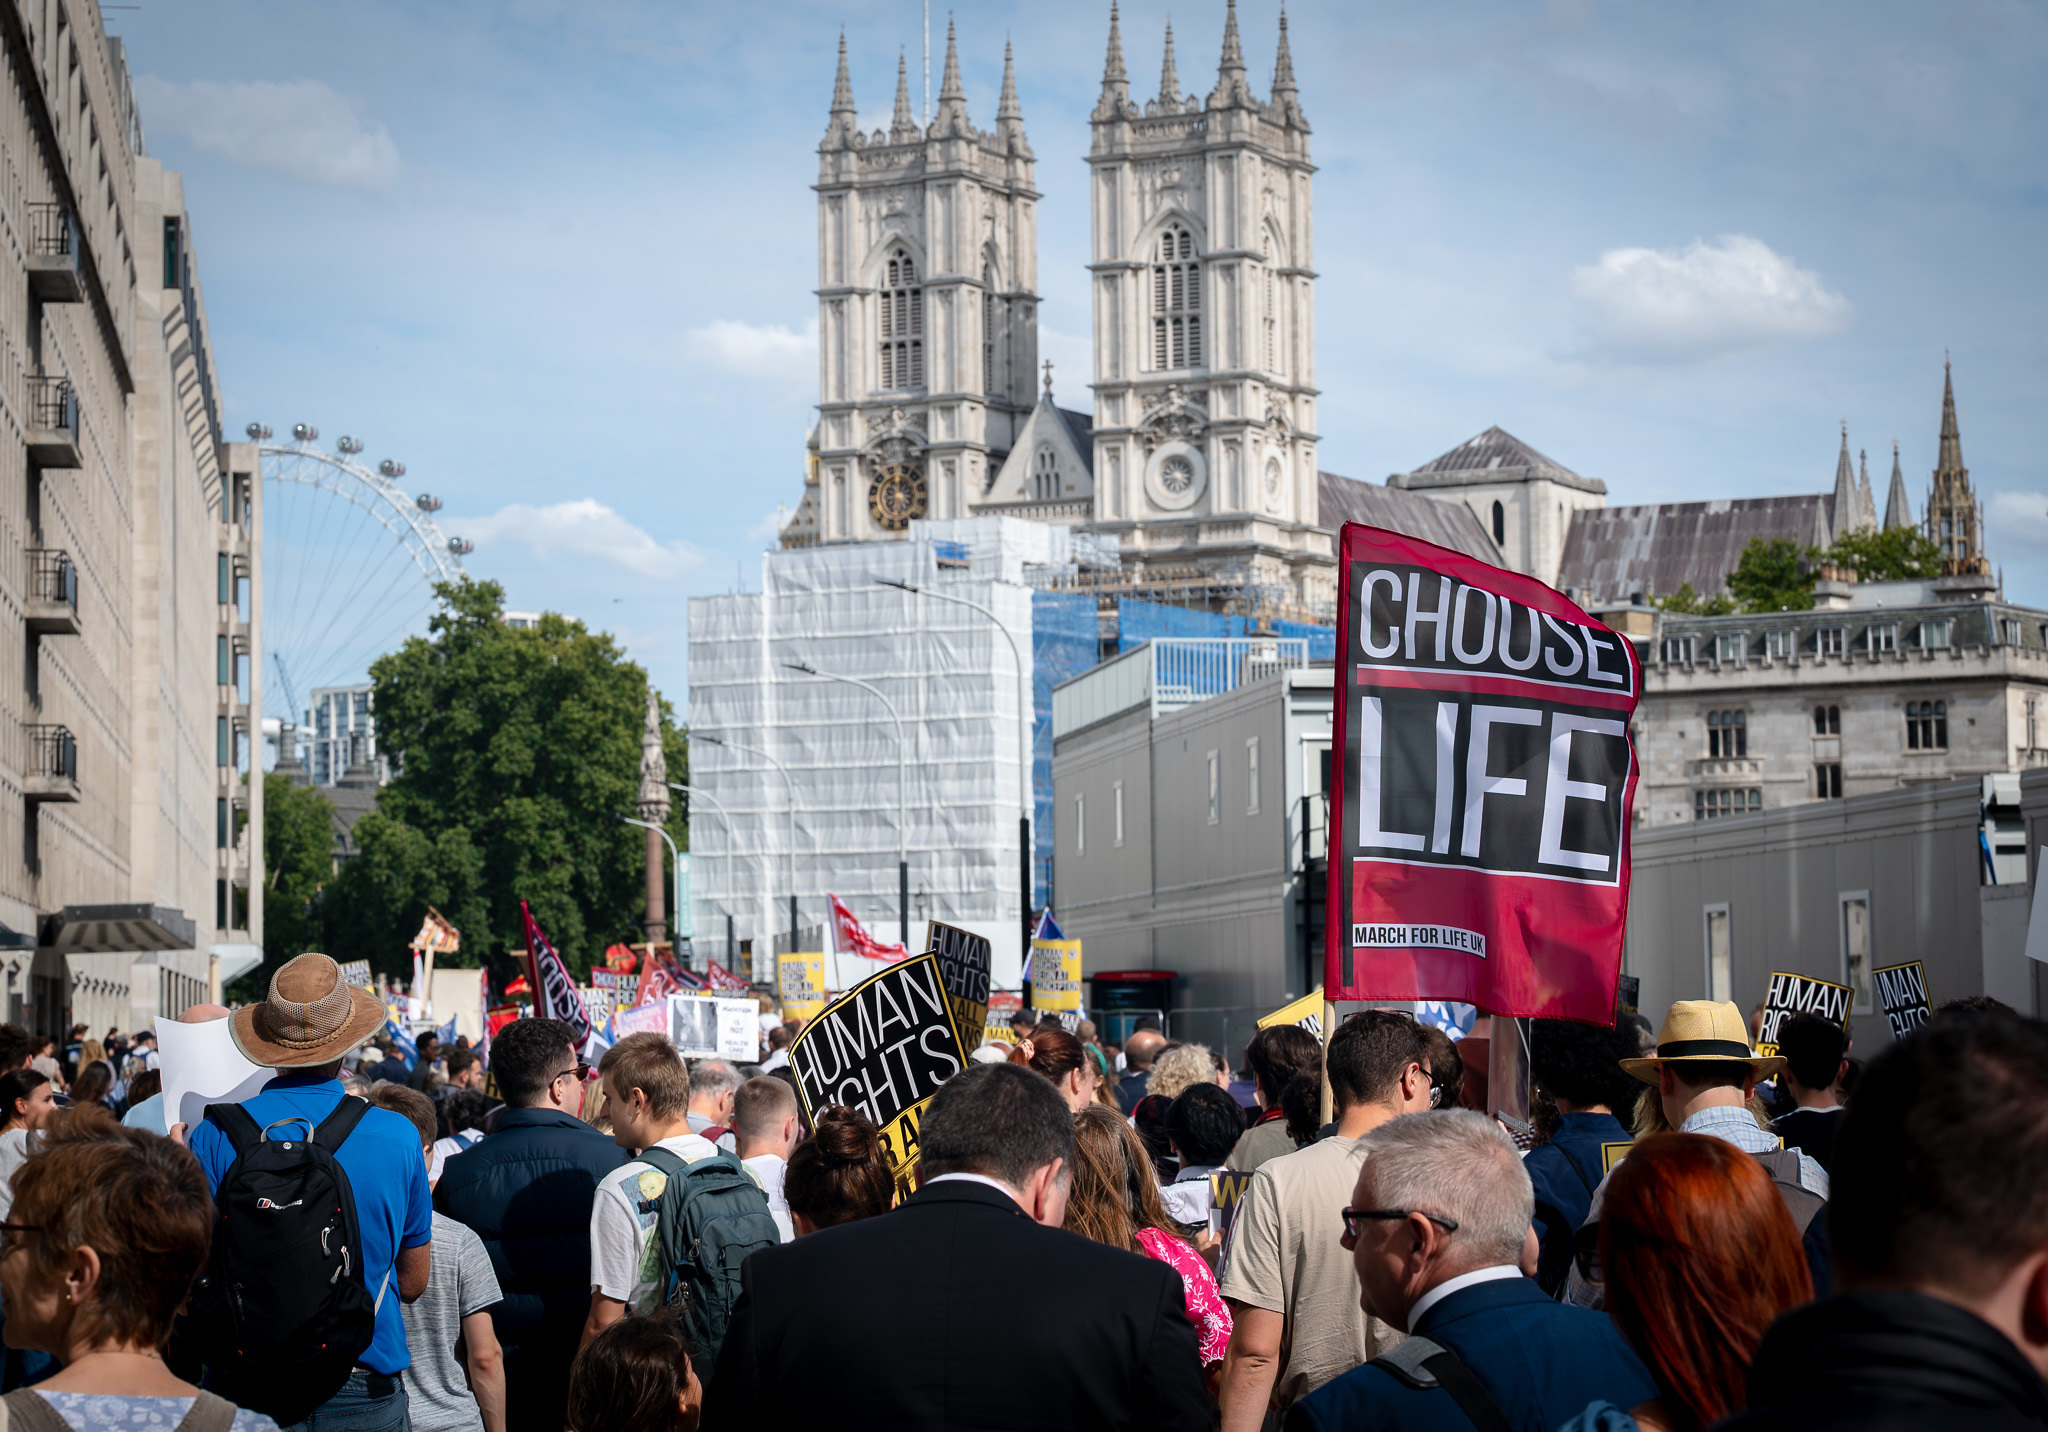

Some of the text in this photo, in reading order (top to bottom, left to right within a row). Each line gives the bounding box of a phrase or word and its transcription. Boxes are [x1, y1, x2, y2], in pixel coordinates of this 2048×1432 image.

[1360, 569, 1624, 684] CHOOSE
[1359, 696, 1625, 872] LIFE
[929, 924, 990, 973] HUMAN
[1355, 926, 1484, 954] MARCH FOR LIFE UK
[792, 960, 944, 1113] HUMAN
[1766, 974, 1850, 1022] HUMAN
